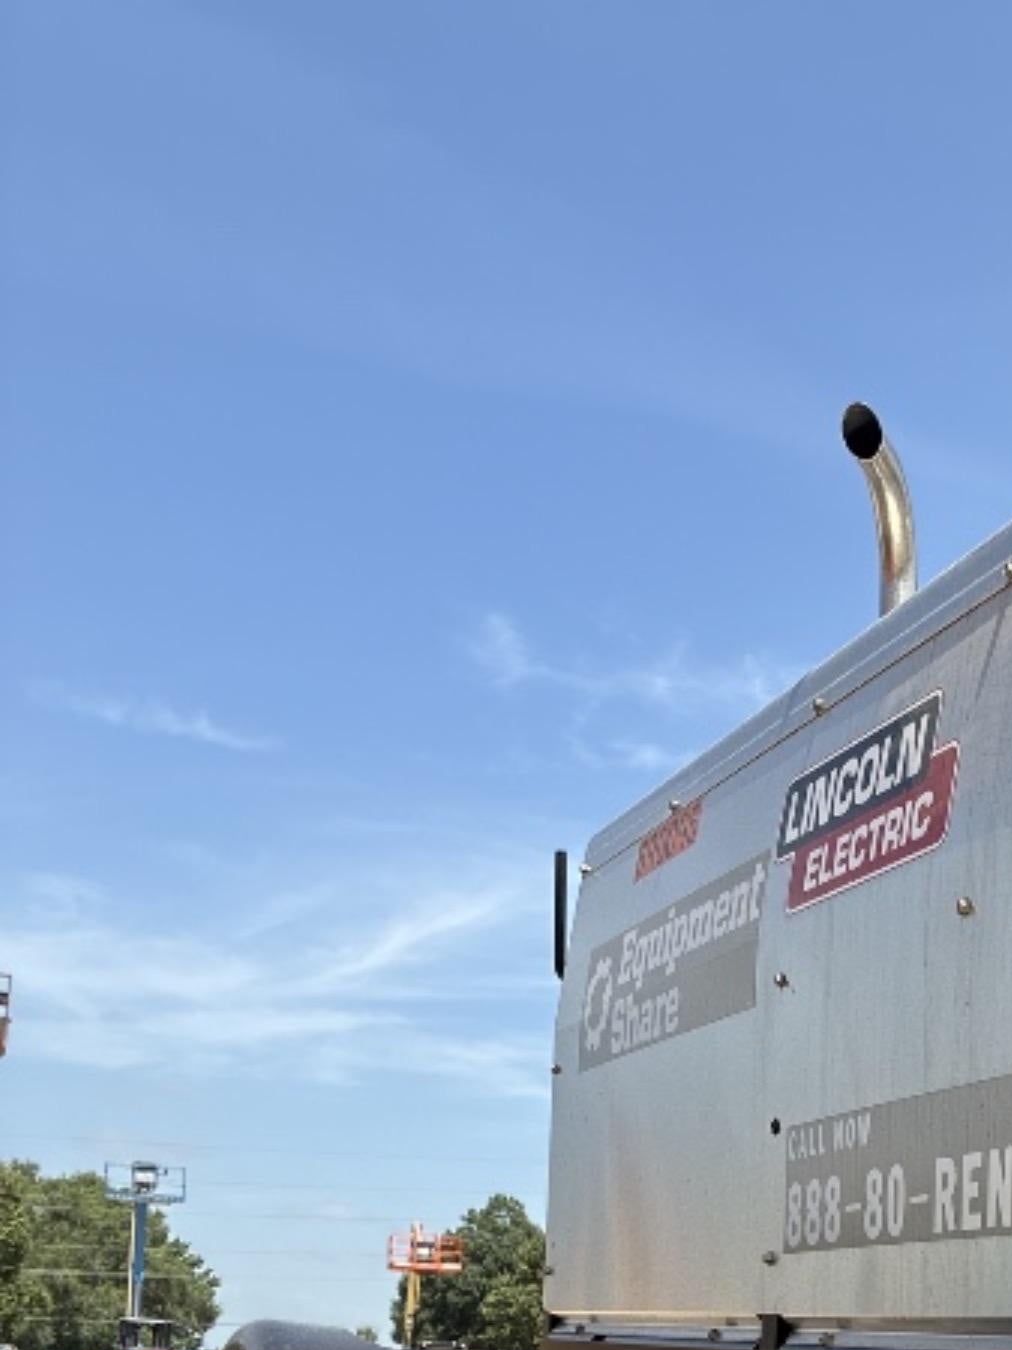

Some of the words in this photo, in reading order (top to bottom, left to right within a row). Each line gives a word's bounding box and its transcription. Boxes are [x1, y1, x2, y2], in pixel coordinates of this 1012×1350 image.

[784, 713, 931, 845] LINCOLN
[802, 790, 935, 892] ELECTRIC
[616, 862, 767, 990] Equipment
[610, 985, 681, 1054] Share
[788, 1123, 826, 1161] CALL
[832, 1111, 872, 1152] NOW
